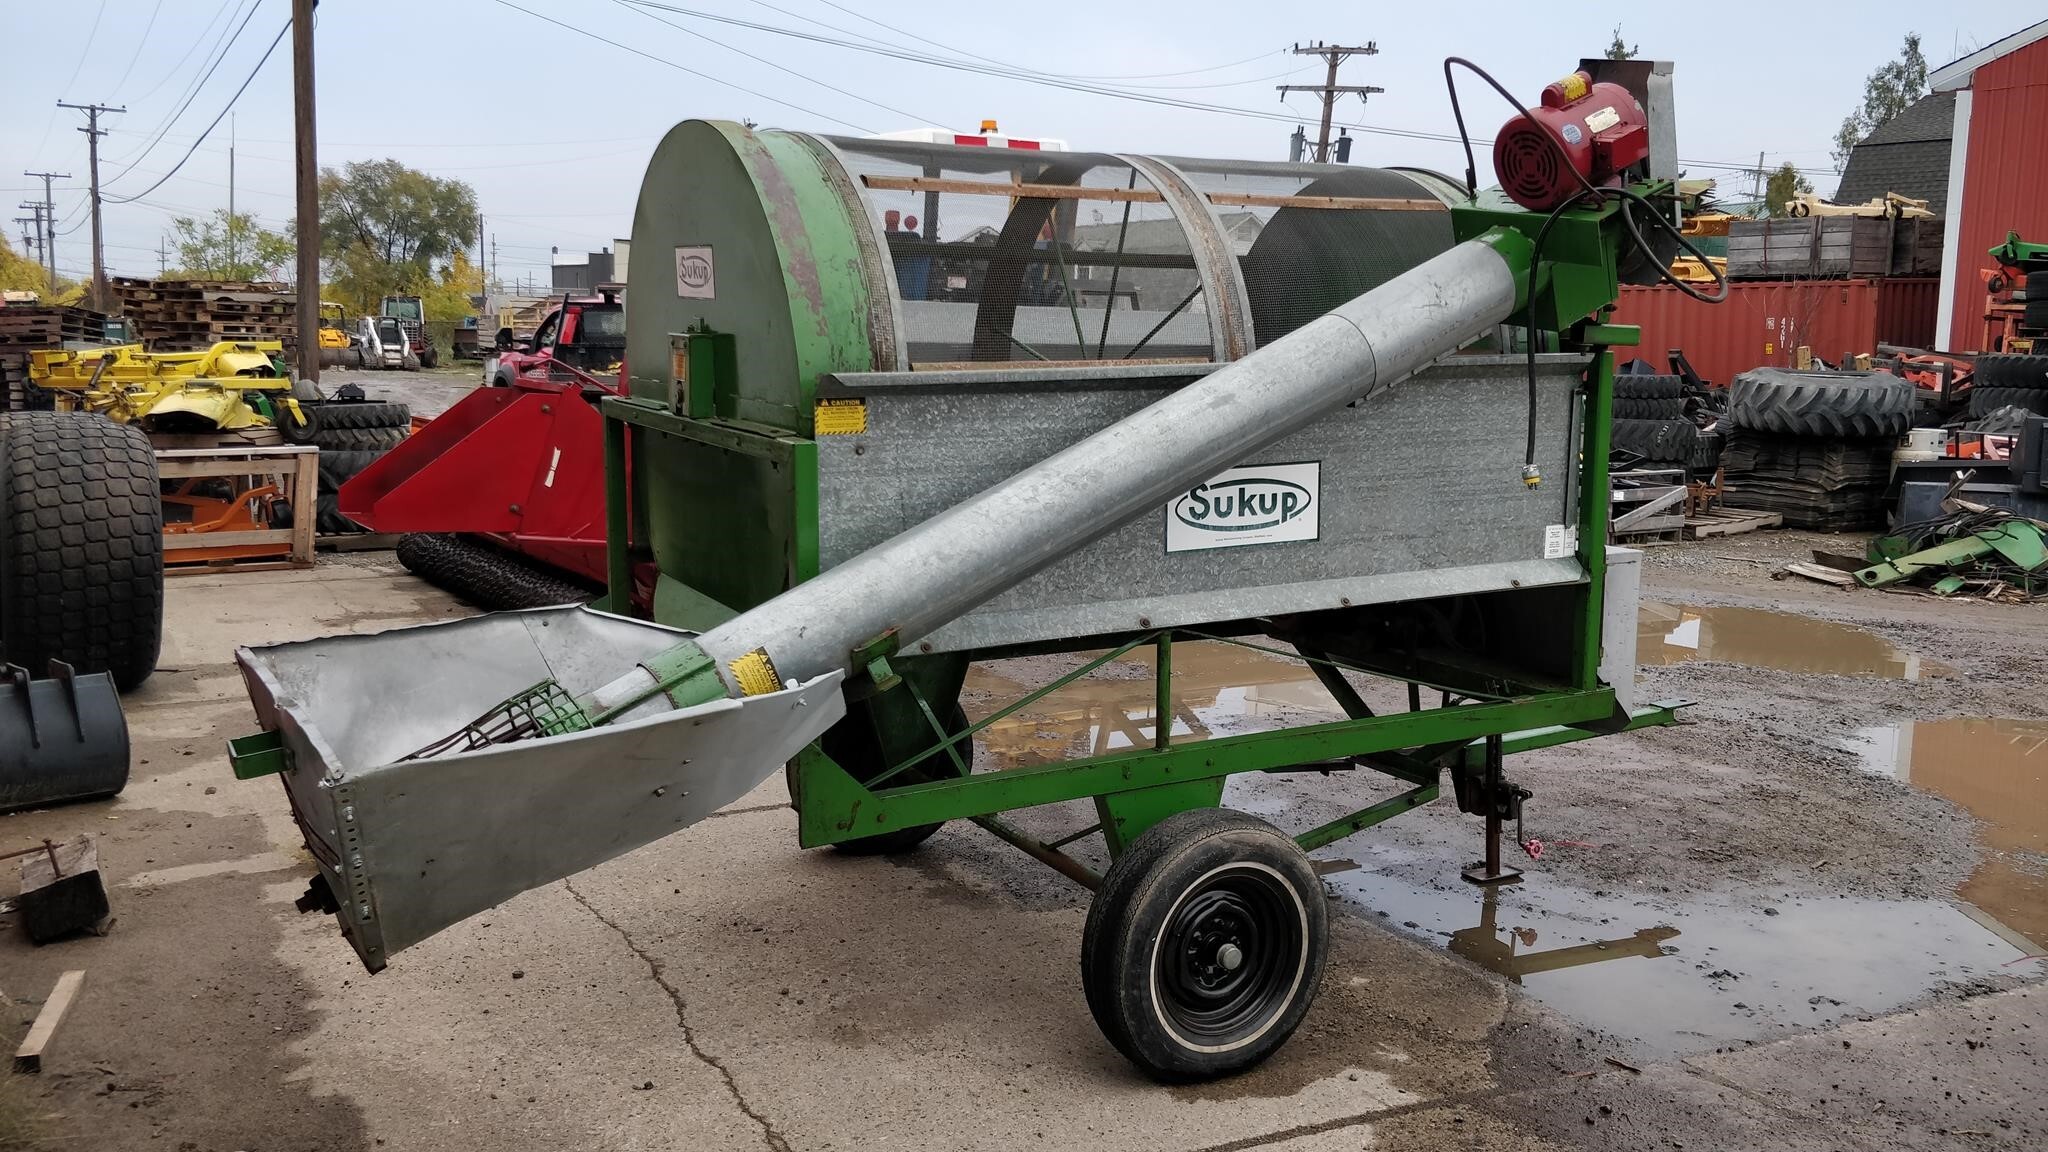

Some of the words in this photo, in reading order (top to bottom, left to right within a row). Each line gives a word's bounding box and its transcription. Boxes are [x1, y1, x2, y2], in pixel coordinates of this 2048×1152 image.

[681, 256, 708, 285] Sukup
[1189, 483, 1298, 524] Sukup
[765, 664, 781, 691] CAUTIO
